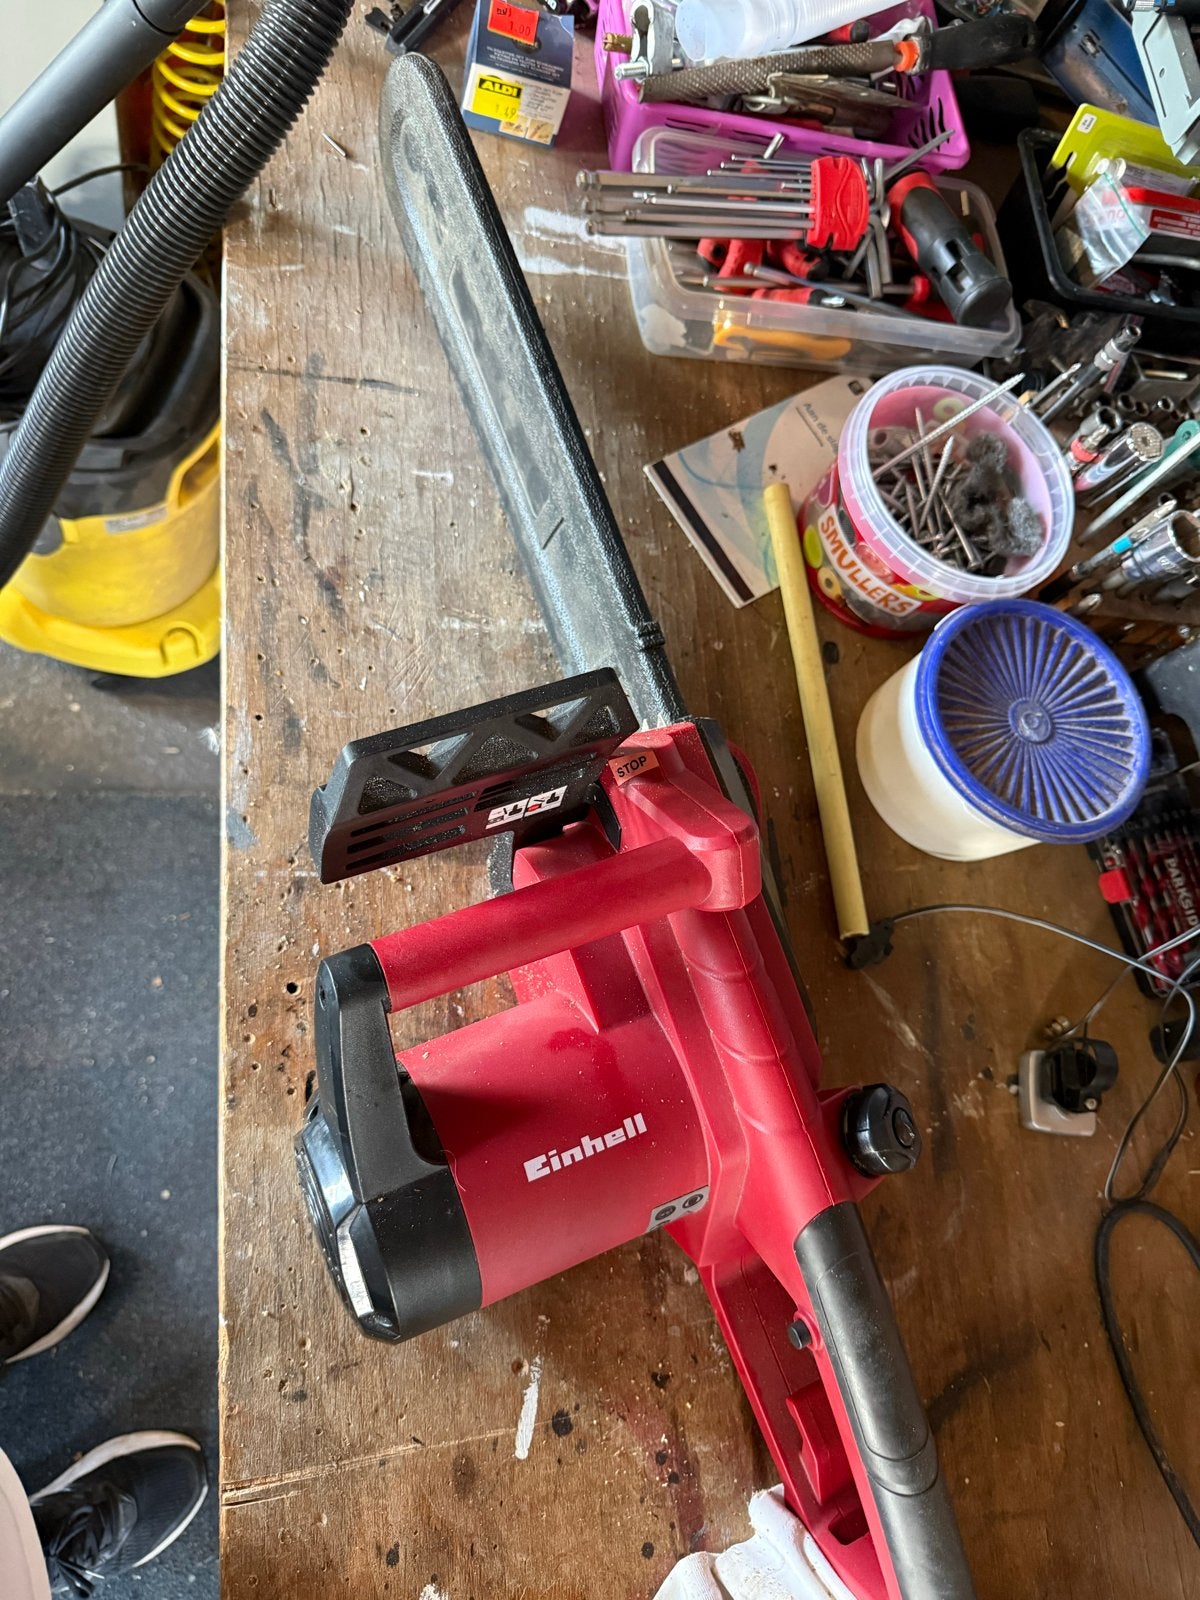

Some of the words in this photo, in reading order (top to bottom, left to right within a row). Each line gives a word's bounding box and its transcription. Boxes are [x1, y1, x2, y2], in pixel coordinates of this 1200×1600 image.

[481, 80, 519, 97] ALDI
[820, 515, 914, 614] SMULLERS
[616, 755, 647, 778] STOP
[1164, 856, 1199, 926] PARKSID
[523, 1112, 648, 1183] Einhell
